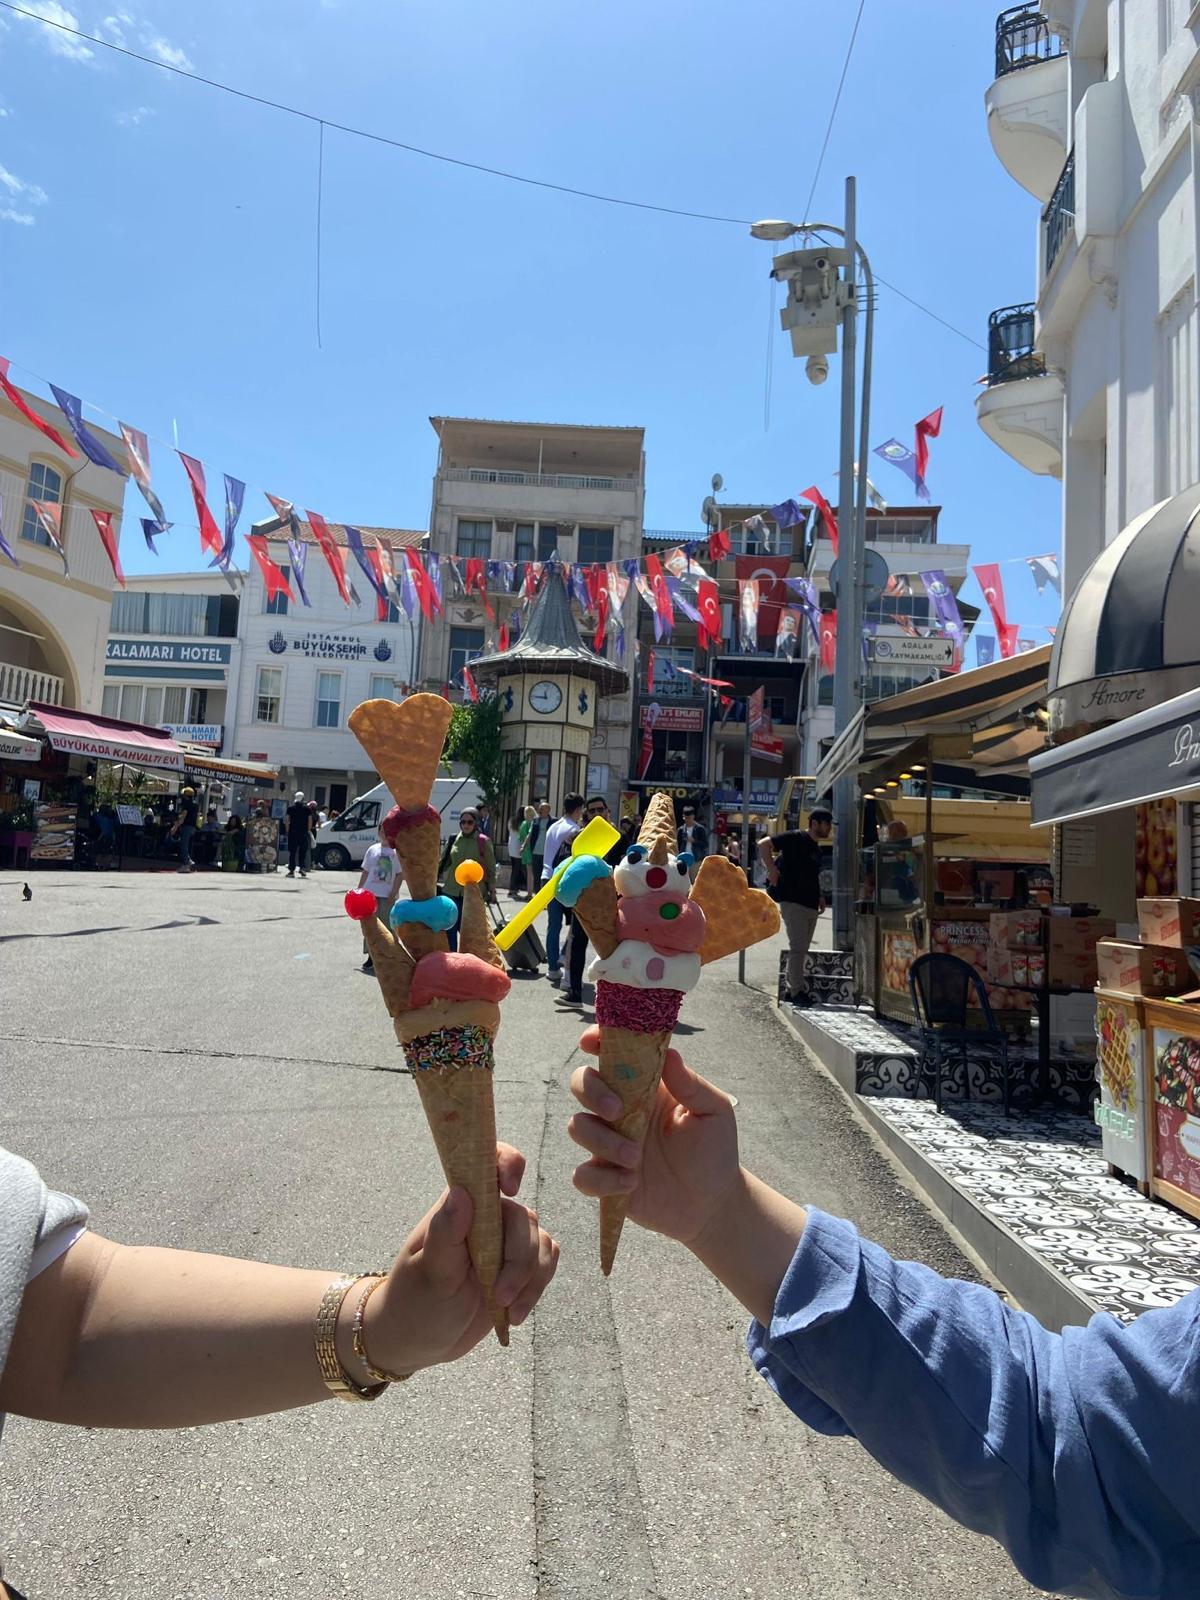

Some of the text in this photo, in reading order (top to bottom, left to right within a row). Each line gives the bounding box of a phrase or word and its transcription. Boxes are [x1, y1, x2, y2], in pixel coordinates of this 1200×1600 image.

[902, 642, 934, 650] ADALAR
[180, 647, 222, 662] HOTEL
[1081, 679, 1146, 709] Amore
[191, 733, 217, 741] HOTEL
[53, 736, 110, 756] BÜYÜKADA
[112, 747, 161, 763] KAHVALTI
[163, 753, 179, 765] EVİ
[645, 786, 687, 798] FOTO
[940, 926, 985, 936] PRINCESS
